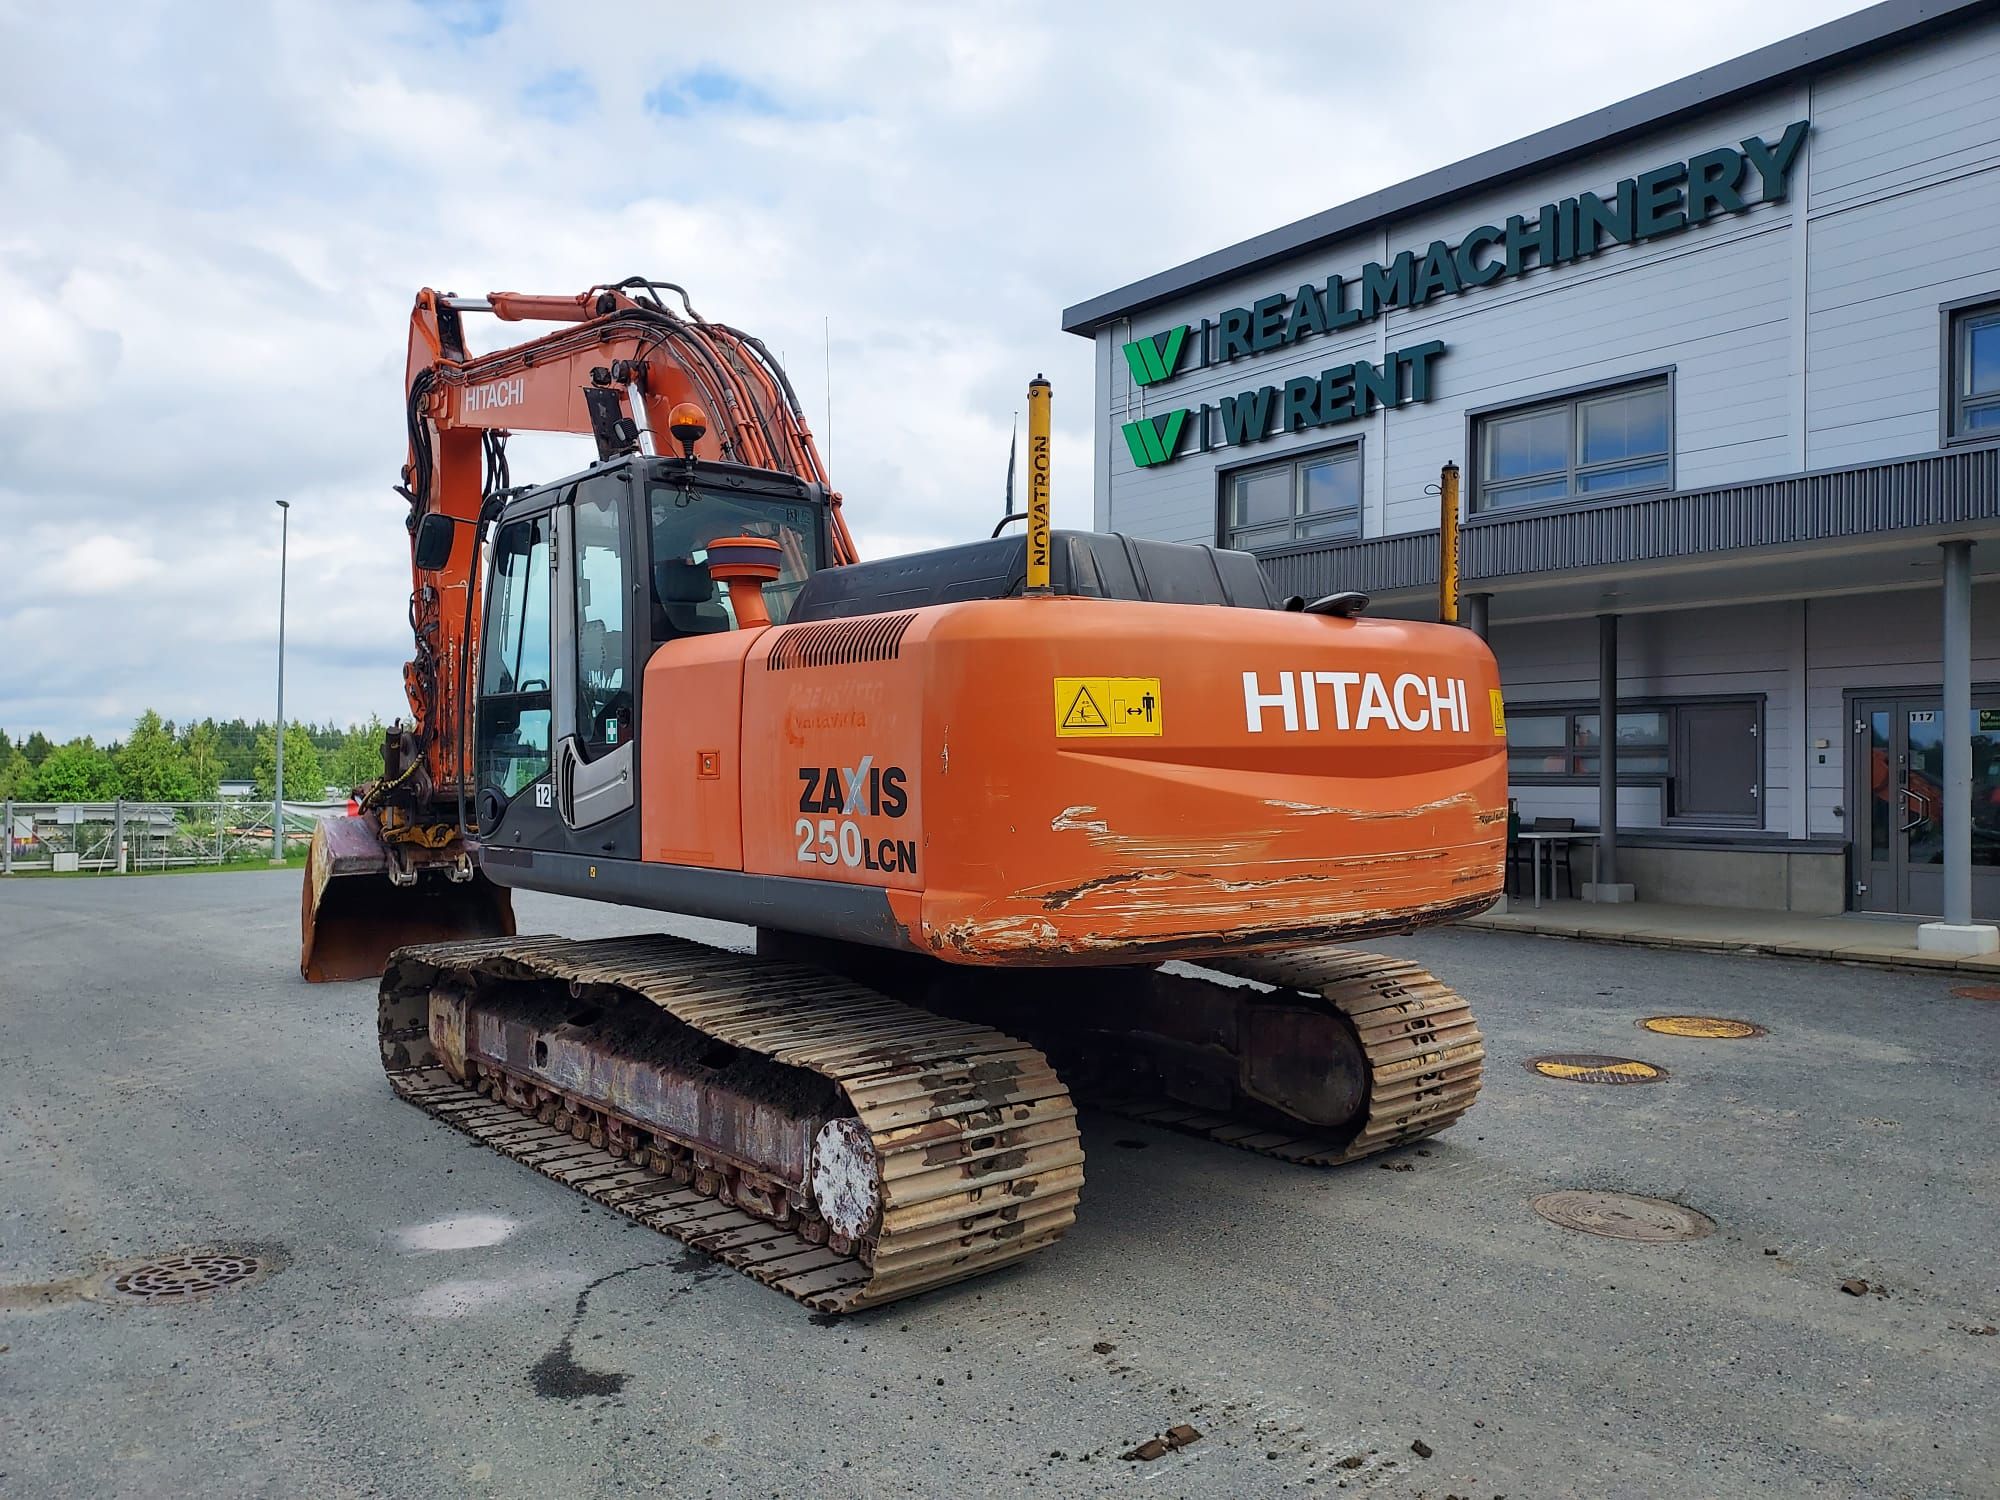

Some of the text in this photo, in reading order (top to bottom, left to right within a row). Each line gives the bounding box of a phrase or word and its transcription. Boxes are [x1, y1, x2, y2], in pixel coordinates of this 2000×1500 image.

[465, 378, 524, 412] HITACHI
[1220, 385, 1275, 445] W
[1284, 339, 1444, 433] RENT
[1034, 436, 1049, 566] NOVATRON
[1242, 671, 1470, 733] HITACHI
[1911, 713, 1933, 722] 117
[537, 786, 550, 805] 12
[799, 755, 908, 818] ZAXIS
